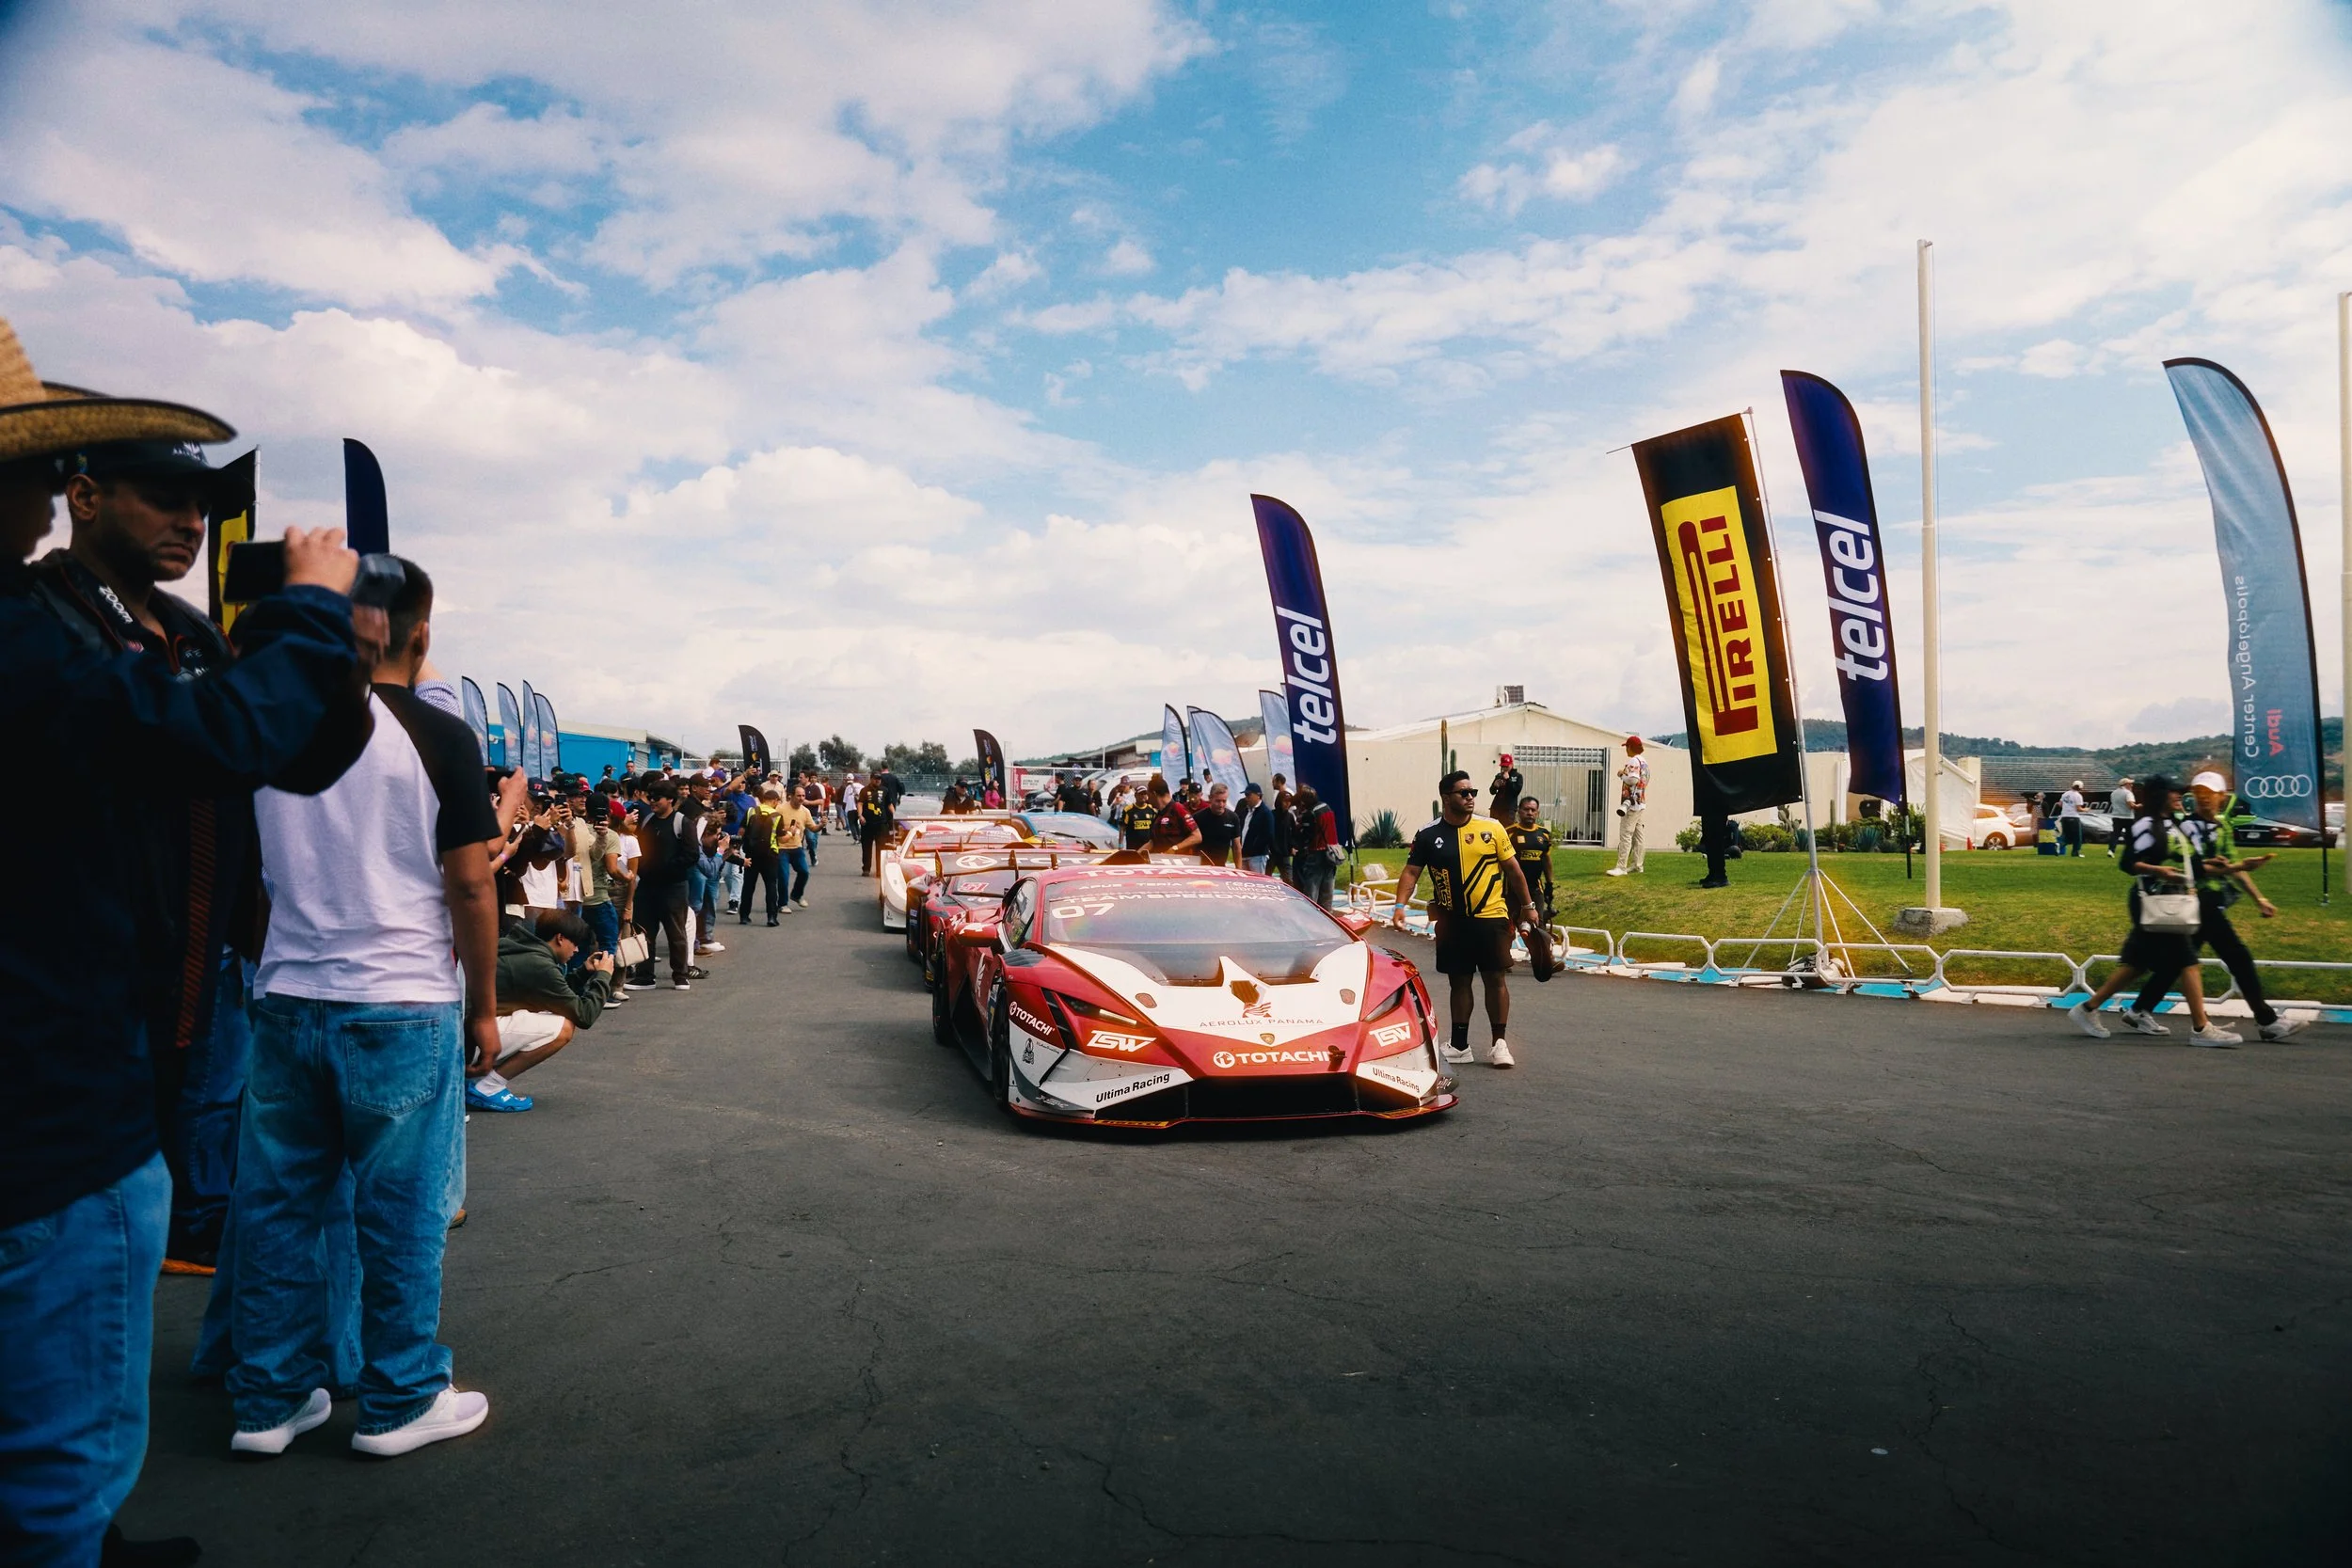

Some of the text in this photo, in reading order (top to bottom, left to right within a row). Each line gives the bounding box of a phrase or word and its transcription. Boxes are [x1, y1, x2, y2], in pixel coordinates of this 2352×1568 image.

[1813, 509, 1888, 681] telcel
[1677, 515, 1758, 736] PIRELLI
[1276, 605, 1337, 745] telcel
[1225, 880, 1281, 890] repsol
[1051, 902, 1115, 919] 07
[1016, 1006, 1053, 1035] TOTACHI
[1200, 1019, 1262, 1027] AEROLUX
[1087, 1030, 1157, 1052] TSW
[1369, 1022, 1410, 1047] TSW
[1236, 1051, 1329, 1064] TOTACHI
[1096, 1073, 1170, 1102] Ultima Racing
[1373, 1067, 1395, 1082] Ultima
[1396, 1076, 1420, 1093] Racing
